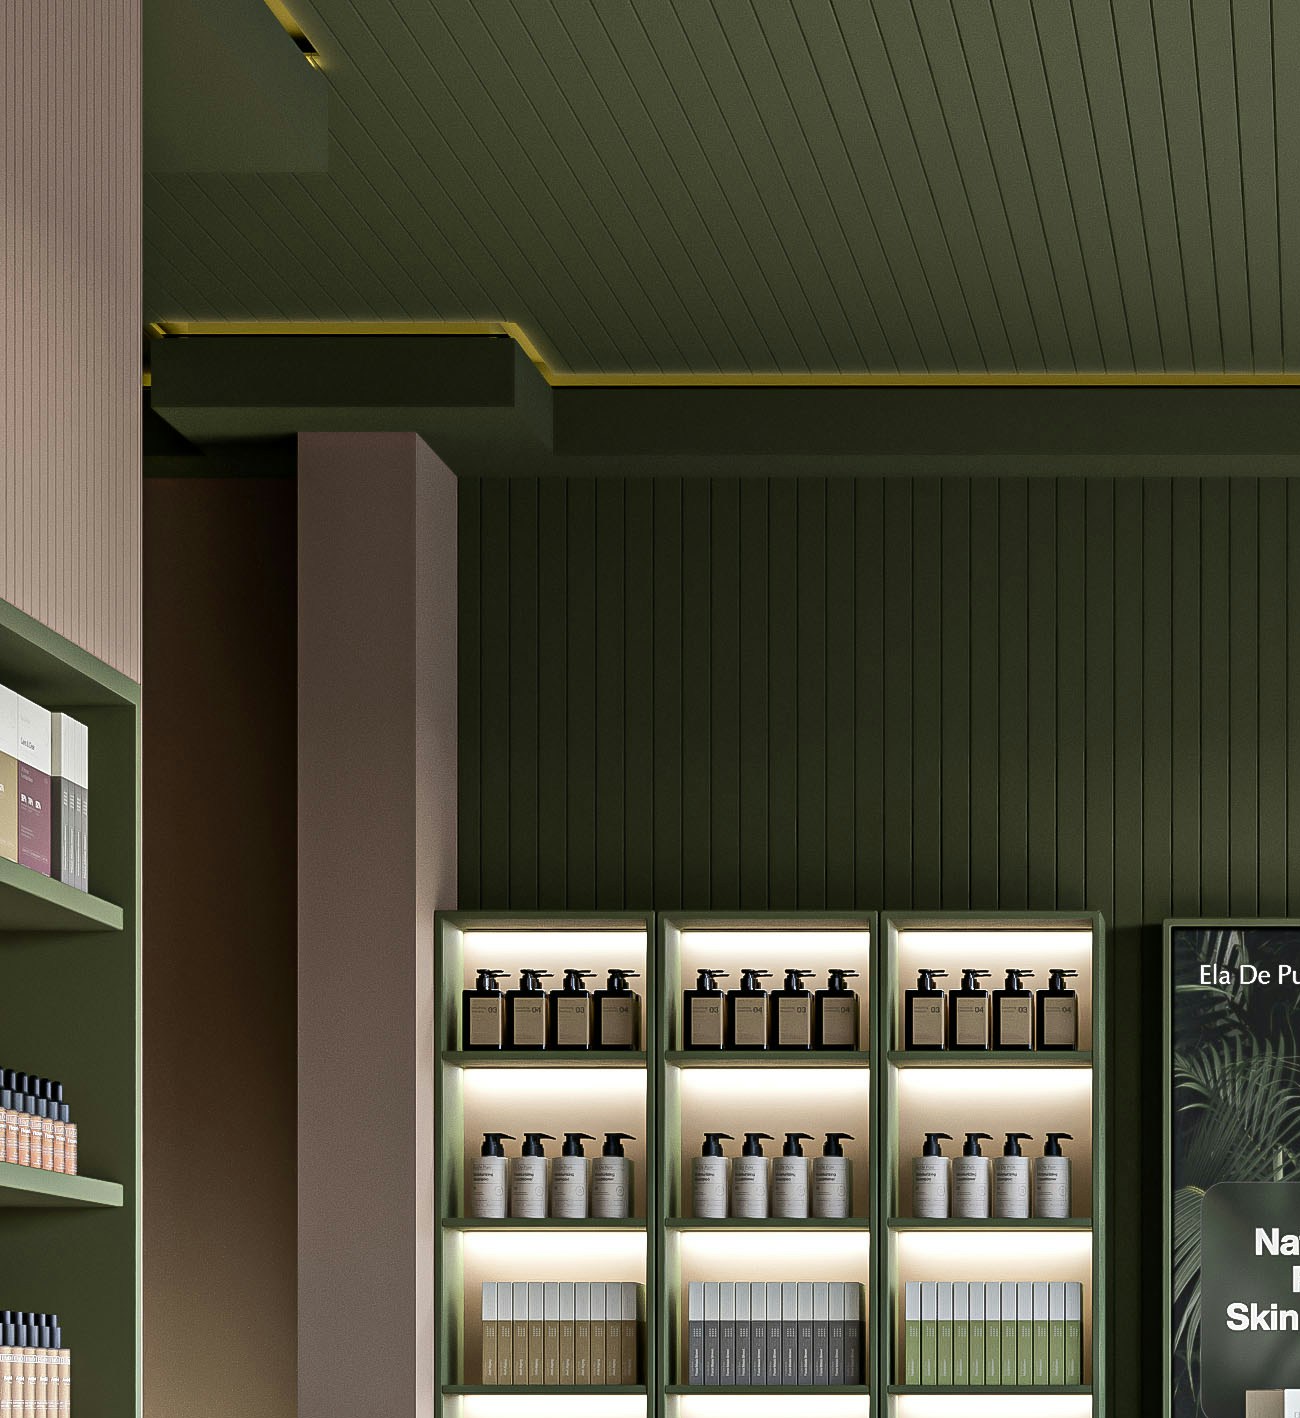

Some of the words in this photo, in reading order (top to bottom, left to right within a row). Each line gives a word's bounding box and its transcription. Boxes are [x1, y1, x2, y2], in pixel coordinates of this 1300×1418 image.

[1200, 964, 1230, 984] Ela
[1240, 965, 1270, 984] De
[1226, 1302, 1299, 1331] Skin
